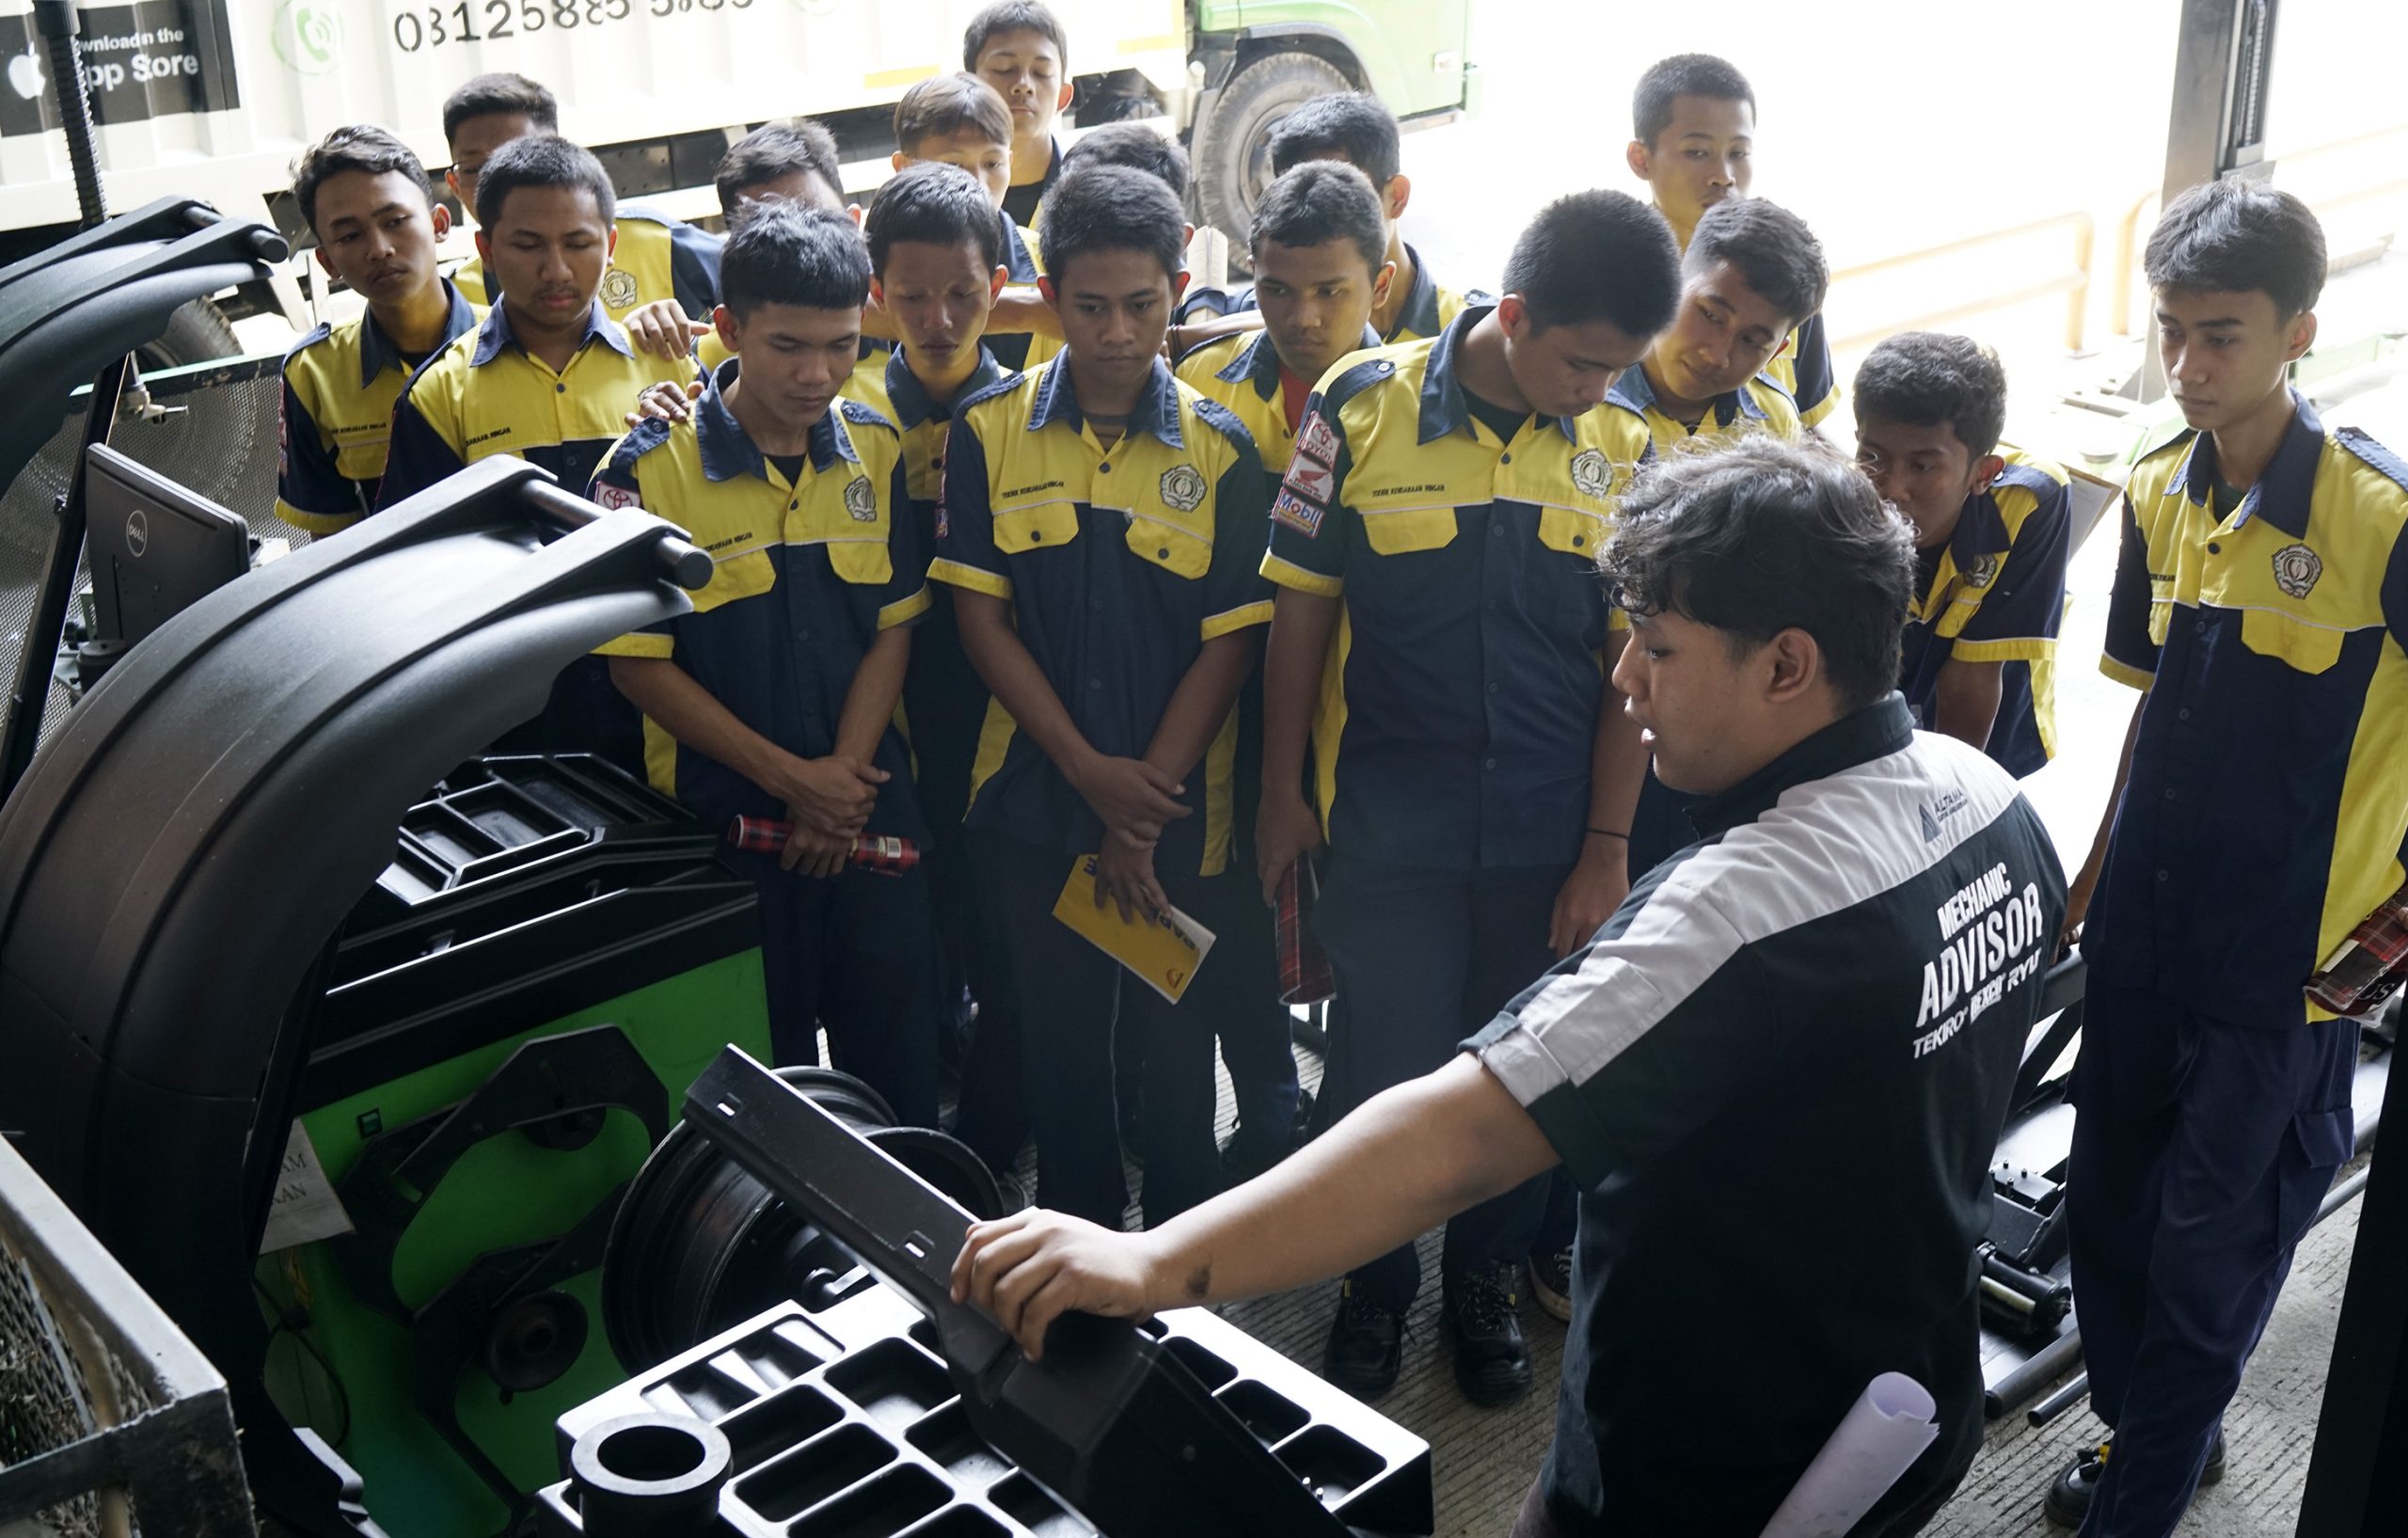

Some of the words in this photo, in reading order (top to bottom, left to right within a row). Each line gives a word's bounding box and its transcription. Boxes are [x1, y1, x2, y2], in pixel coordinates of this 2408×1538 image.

[80, 33, 141, 52] wnload
[157, 27, 184, 43] the
[84, 63, 124, 92] pp
[1280, 492, 1322, 526] Mobil
[129, 524, 144, 542] DELL
[1937, 862, 2012, 942] MECHANIC
[1915, 881, 2043, 1028] ADVISOR
[1913, 1009, 1966, 1059] TEKIRO
[2007, 946, 2042, 992] RYU
